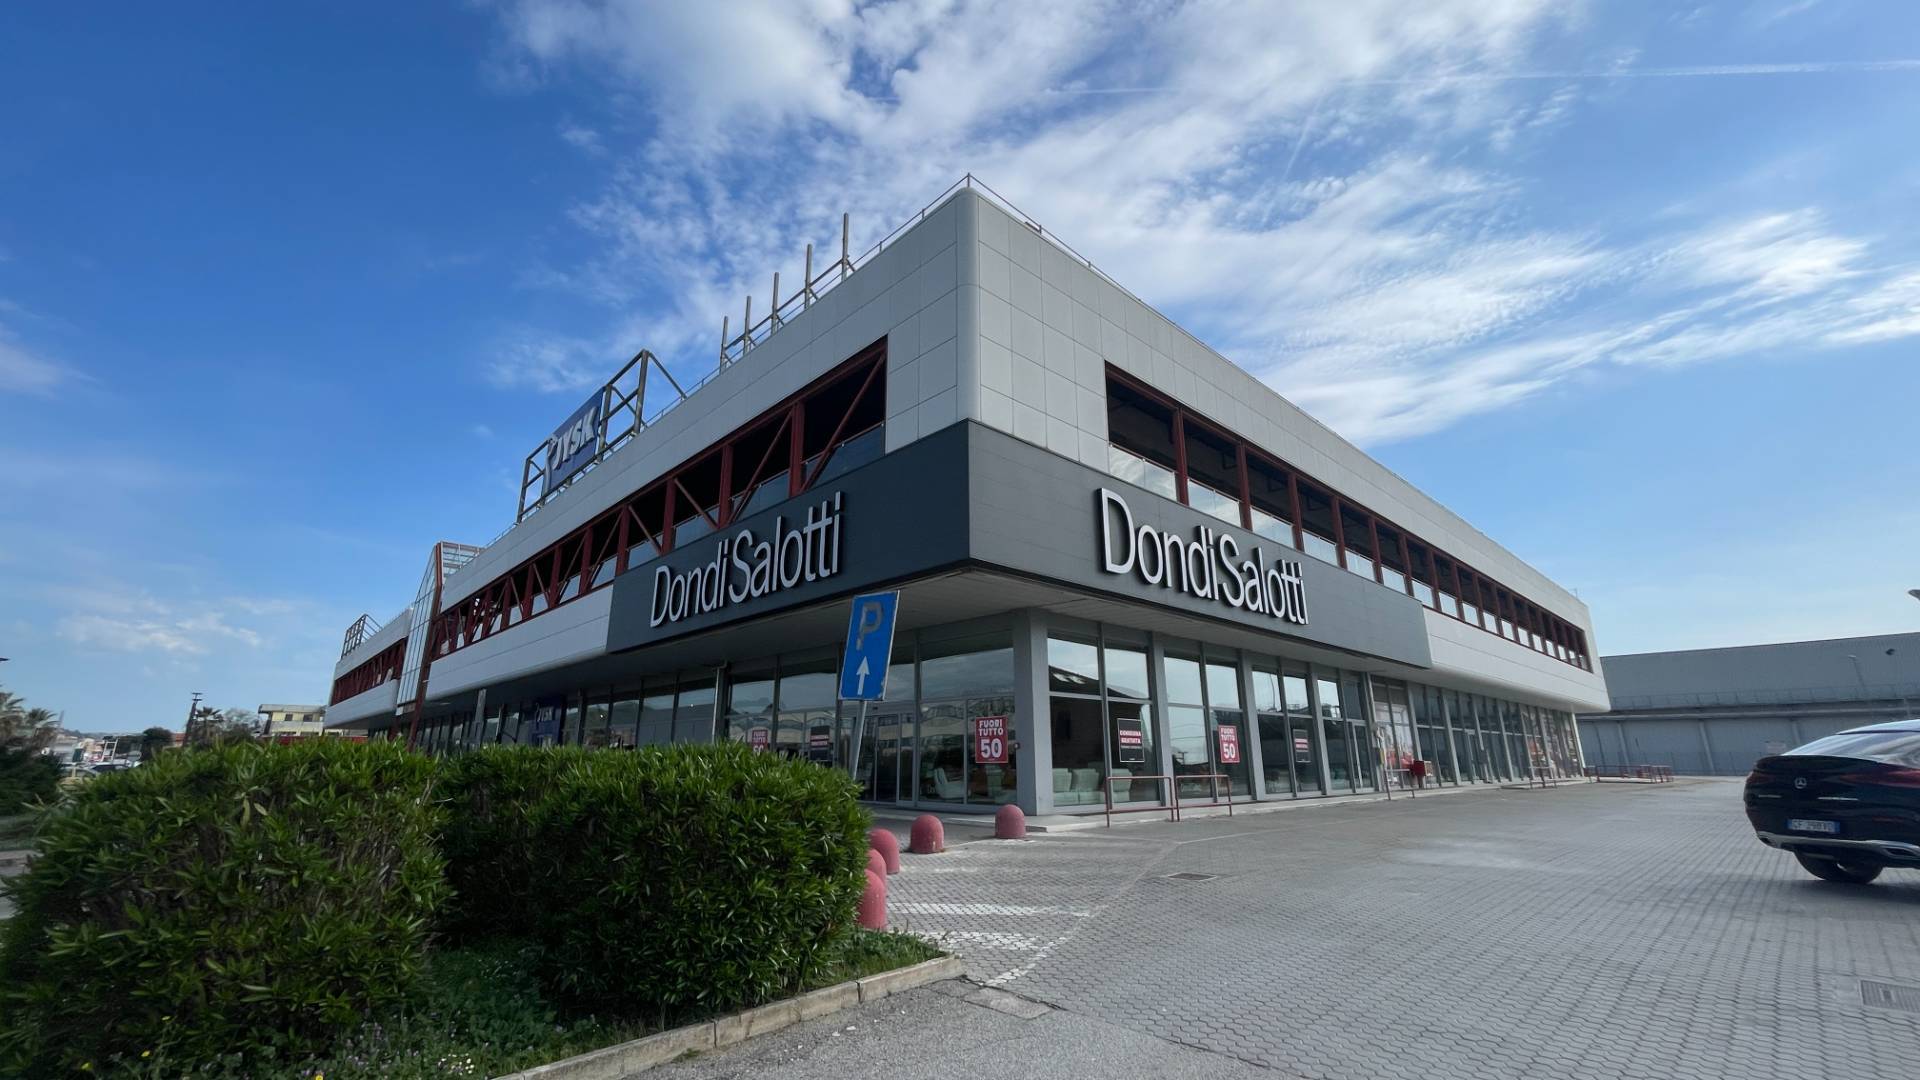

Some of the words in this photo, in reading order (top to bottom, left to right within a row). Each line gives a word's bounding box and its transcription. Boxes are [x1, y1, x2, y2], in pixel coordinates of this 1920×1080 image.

[856, 602, 884, 651] P
[978, 719, 1003, 729] FUORI
[978, 727, 1004, 737] TUTTO
[980, 738, 1003, 758] 50
[1222, 743, 1236, 759] 50
